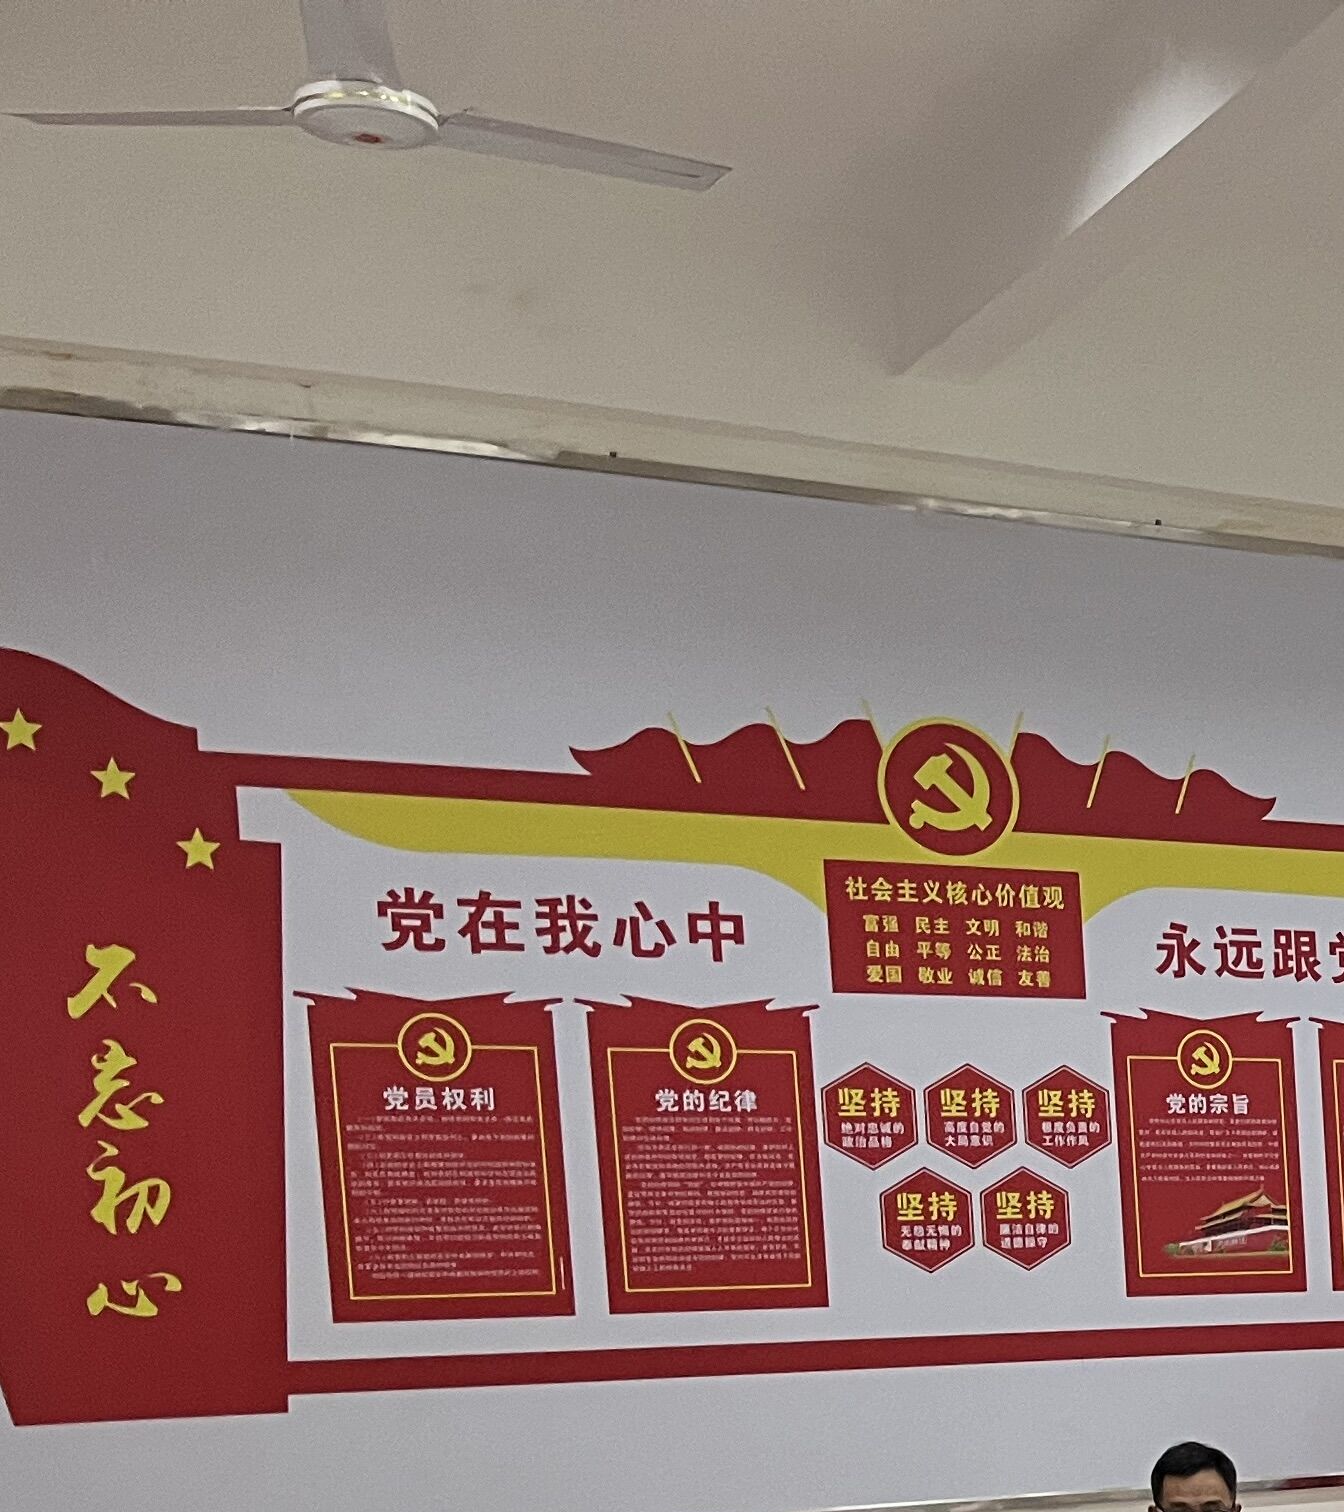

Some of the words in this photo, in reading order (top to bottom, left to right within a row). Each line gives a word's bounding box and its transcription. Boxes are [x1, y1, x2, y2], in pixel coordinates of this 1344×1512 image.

[845, 876, 1066, 910] 社会主义核心价值观
[376, 887, 746, 965] 党在我心中
[863, 914, 900, 933] 富强
[915, 916, 950, 934] 民主
[965, 918, 1000, 937] 文明
[1015, 920, 1049, 939] 和谐
[866, 939, 900, 959] 自由
[916, 941, 951, 960] 平等
[967, 943, 1001, 961] 公正
[1016, 945, 1050, 963] 法治
[866, 965, 902, 984] 爱国
[918, 966, 953, 985] 敬业
[968, 968, 1003, 986] 诚信
[1018, 969, 1051, 988] 友善
[383, 1086, 496, 1112] 党员权利
[655, 1088, 758, 1113] 党的纪律
[838, 1087, 901, 1118] 坚持
[940, 1087, 1001, 1118] 坚持
[1038, 1088, 1095, 1118] 坚持
[1166, 1093, 1250, 1115] 党的宗旨
[66, 942, 183, 1319] 不忘初心
[896, 1191, 958, 1222] 坚持
[995, 1190, 1055, 1220] 坚持
